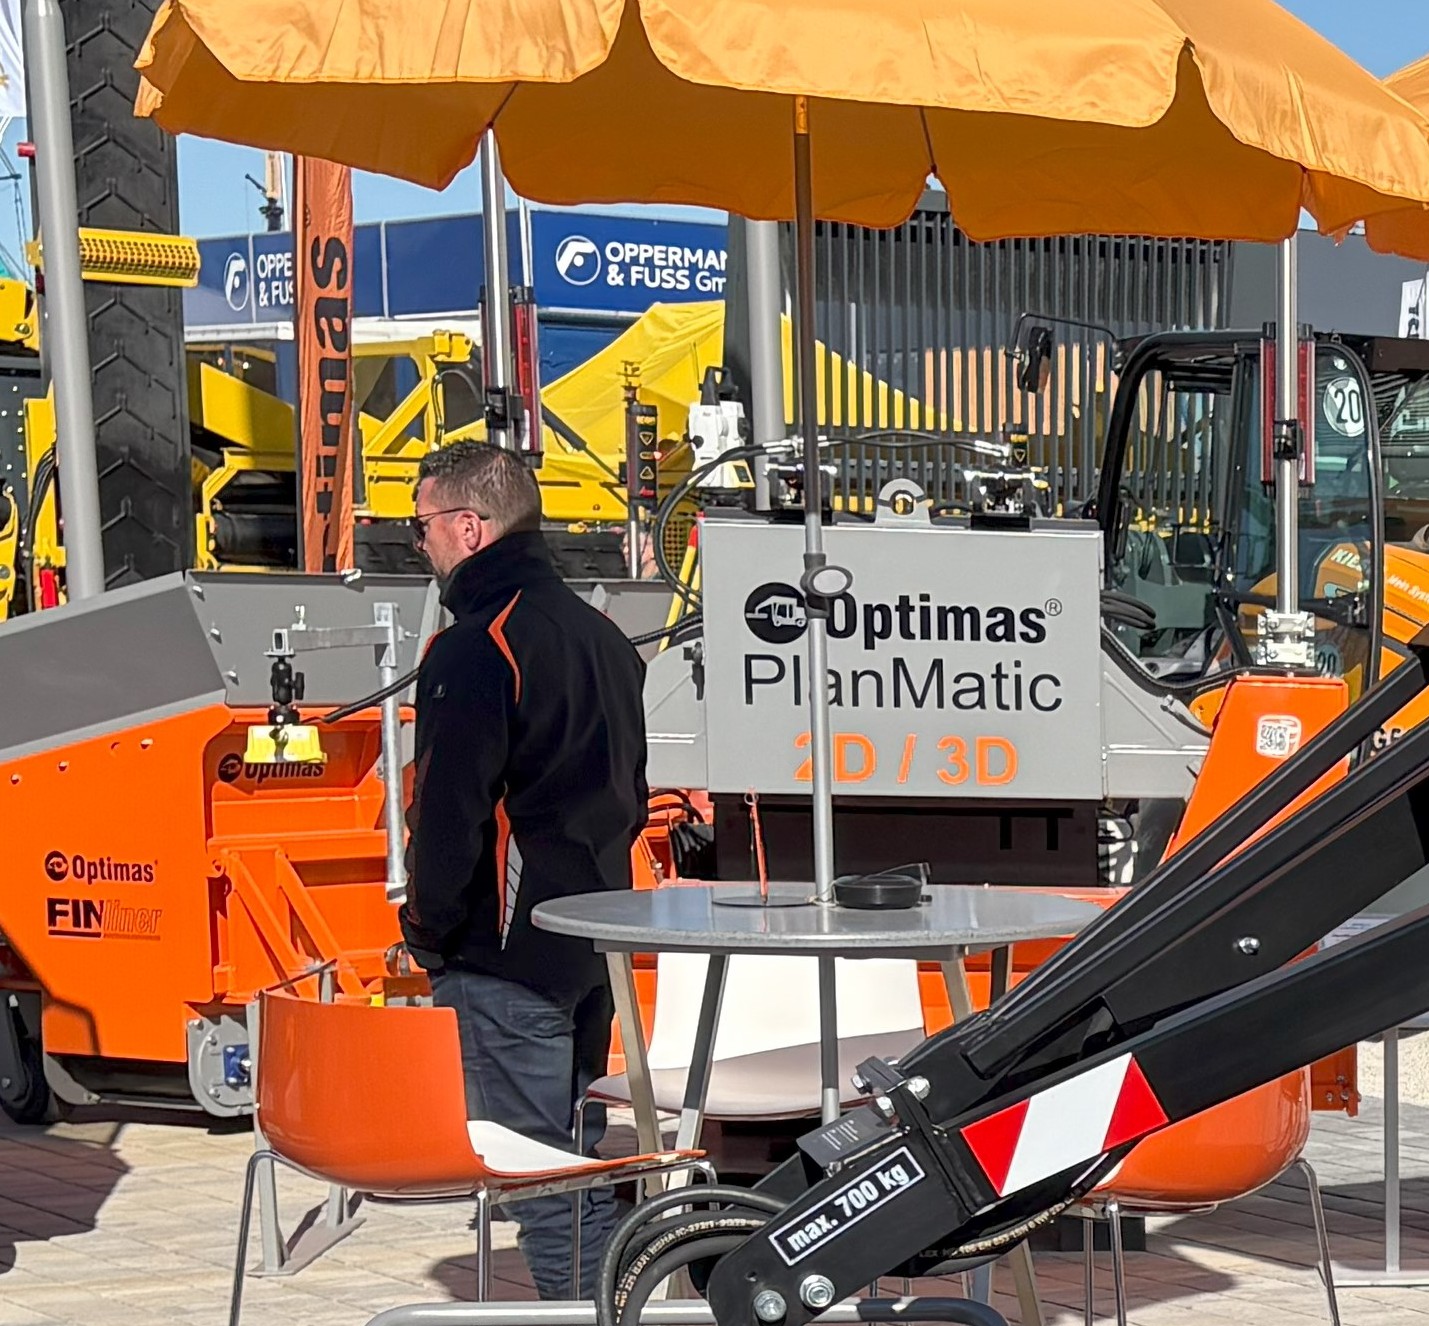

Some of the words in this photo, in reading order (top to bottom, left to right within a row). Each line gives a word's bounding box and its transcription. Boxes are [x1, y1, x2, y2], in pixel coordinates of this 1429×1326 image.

[607, 264, 624, 286] &
[630, 266, 690, 290] FUSS
[258, 281, 269, 307] &
[1334, 389, 1362, 424] 20
[936, 734, 1019, 787] 3D
[72, 854, 154, 886] Optimas
[786, 1213, 839, 1252] max.
[833, 1179, 880, 1218] 700
[875, 1163, 910, 1191] kg
